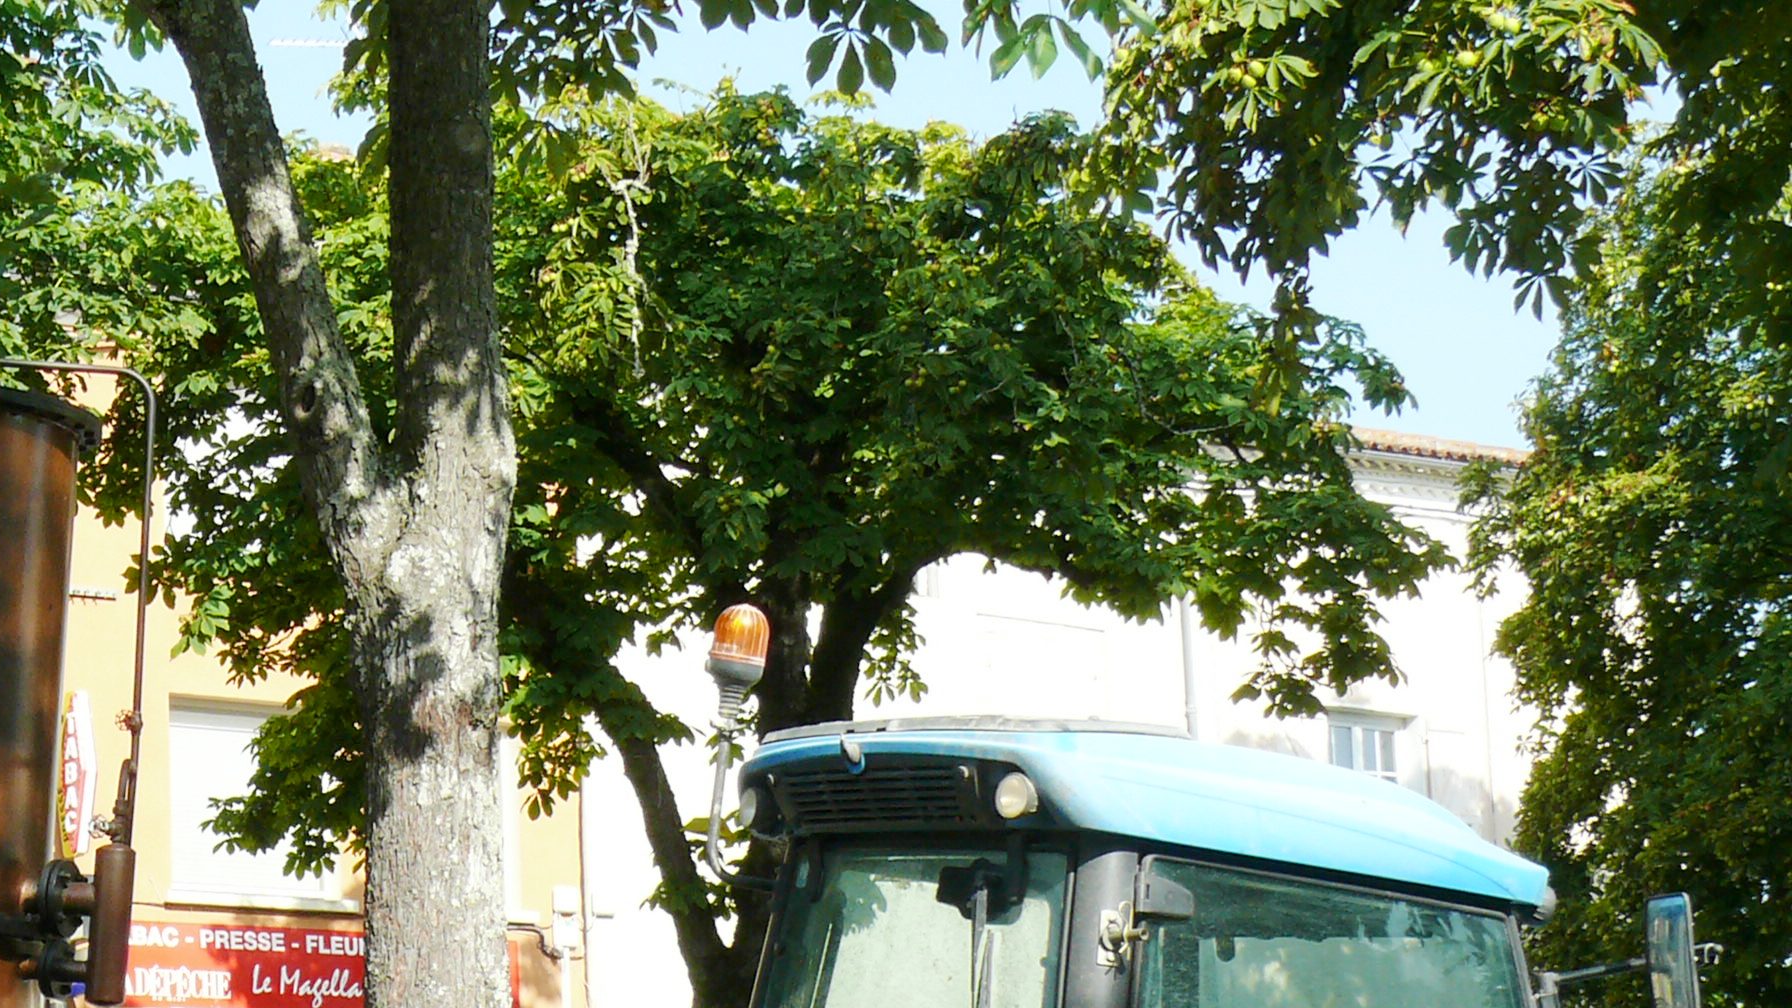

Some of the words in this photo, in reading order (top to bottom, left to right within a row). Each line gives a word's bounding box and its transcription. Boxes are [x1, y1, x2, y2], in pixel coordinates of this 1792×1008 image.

[64, 711, 79, 833] TABAC
[129, 924, 180, 949] BAC
[198, 928, 287, 953] PRESSE
[251, 963, 273, 995] Le
